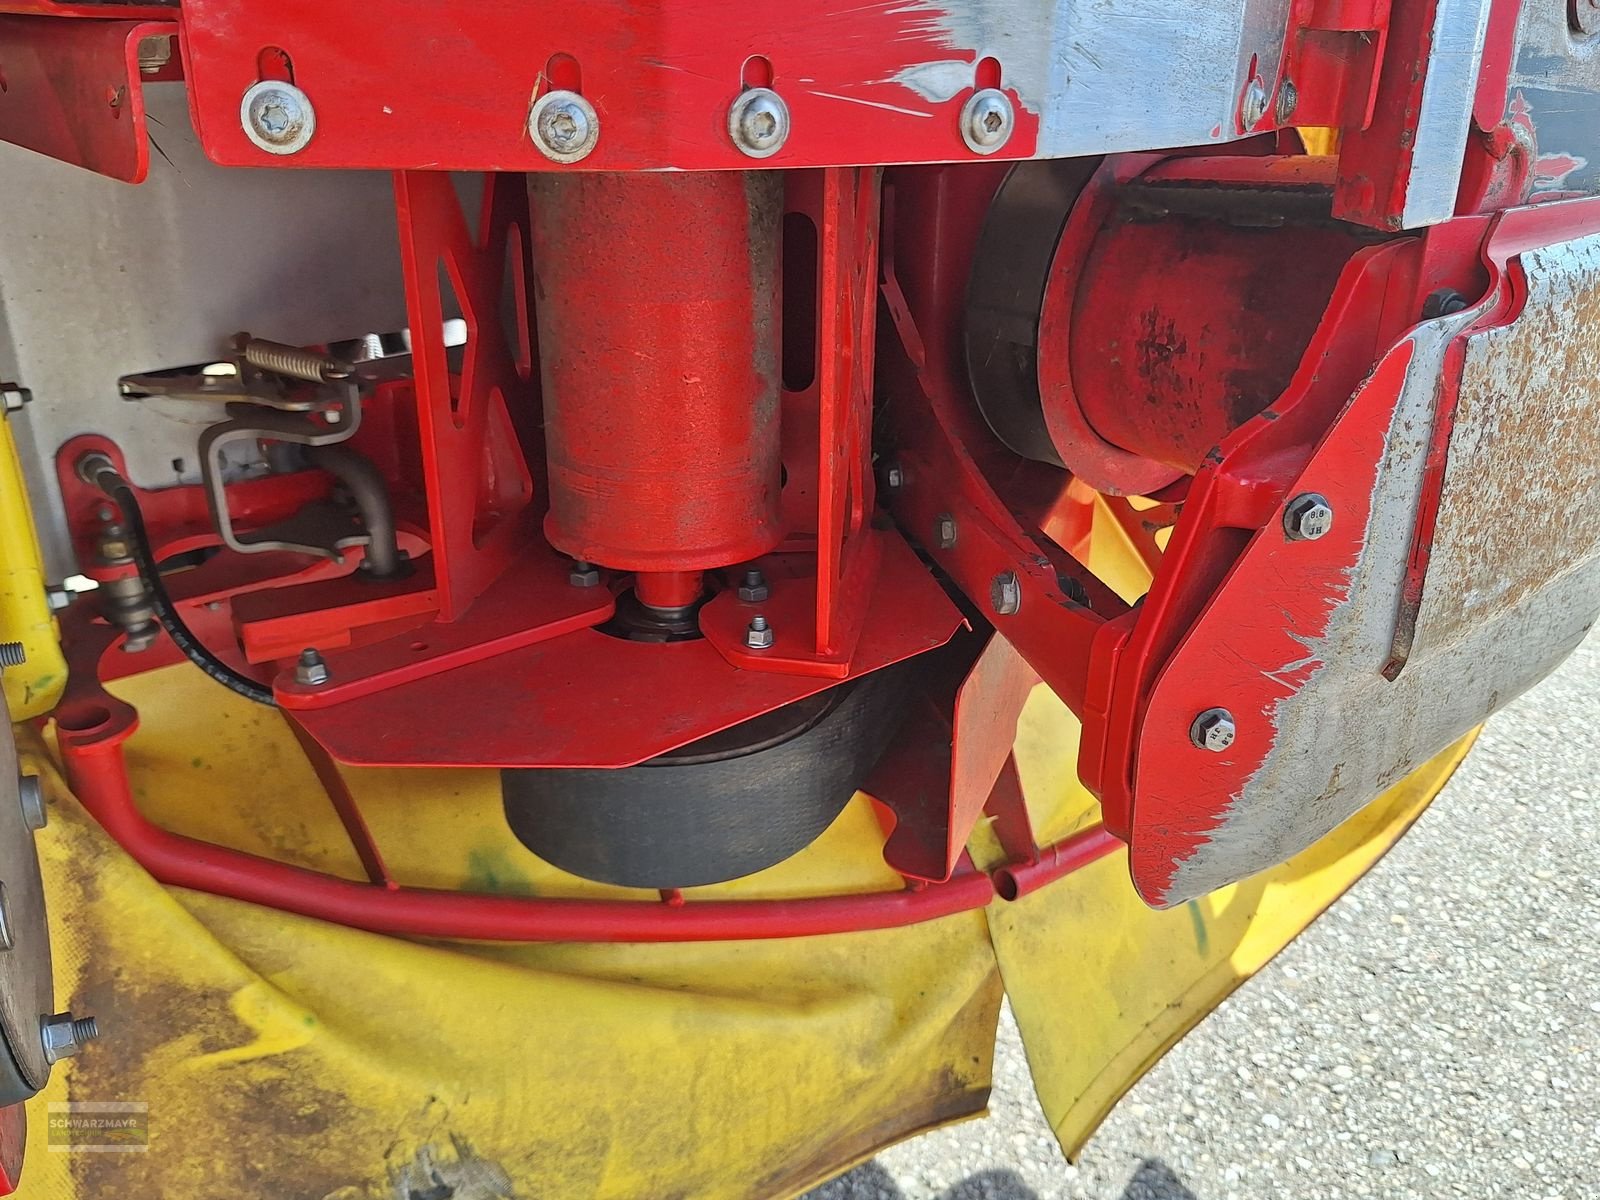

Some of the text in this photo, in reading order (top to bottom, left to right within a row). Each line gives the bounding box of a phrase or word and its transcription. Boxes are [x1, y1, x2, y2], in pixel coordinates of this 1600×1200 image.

[1310, 510, 1324, 518] 8.8
[1309, 527, 1322, 535] JH
[1222, 733, 1233, 745] 8.8
